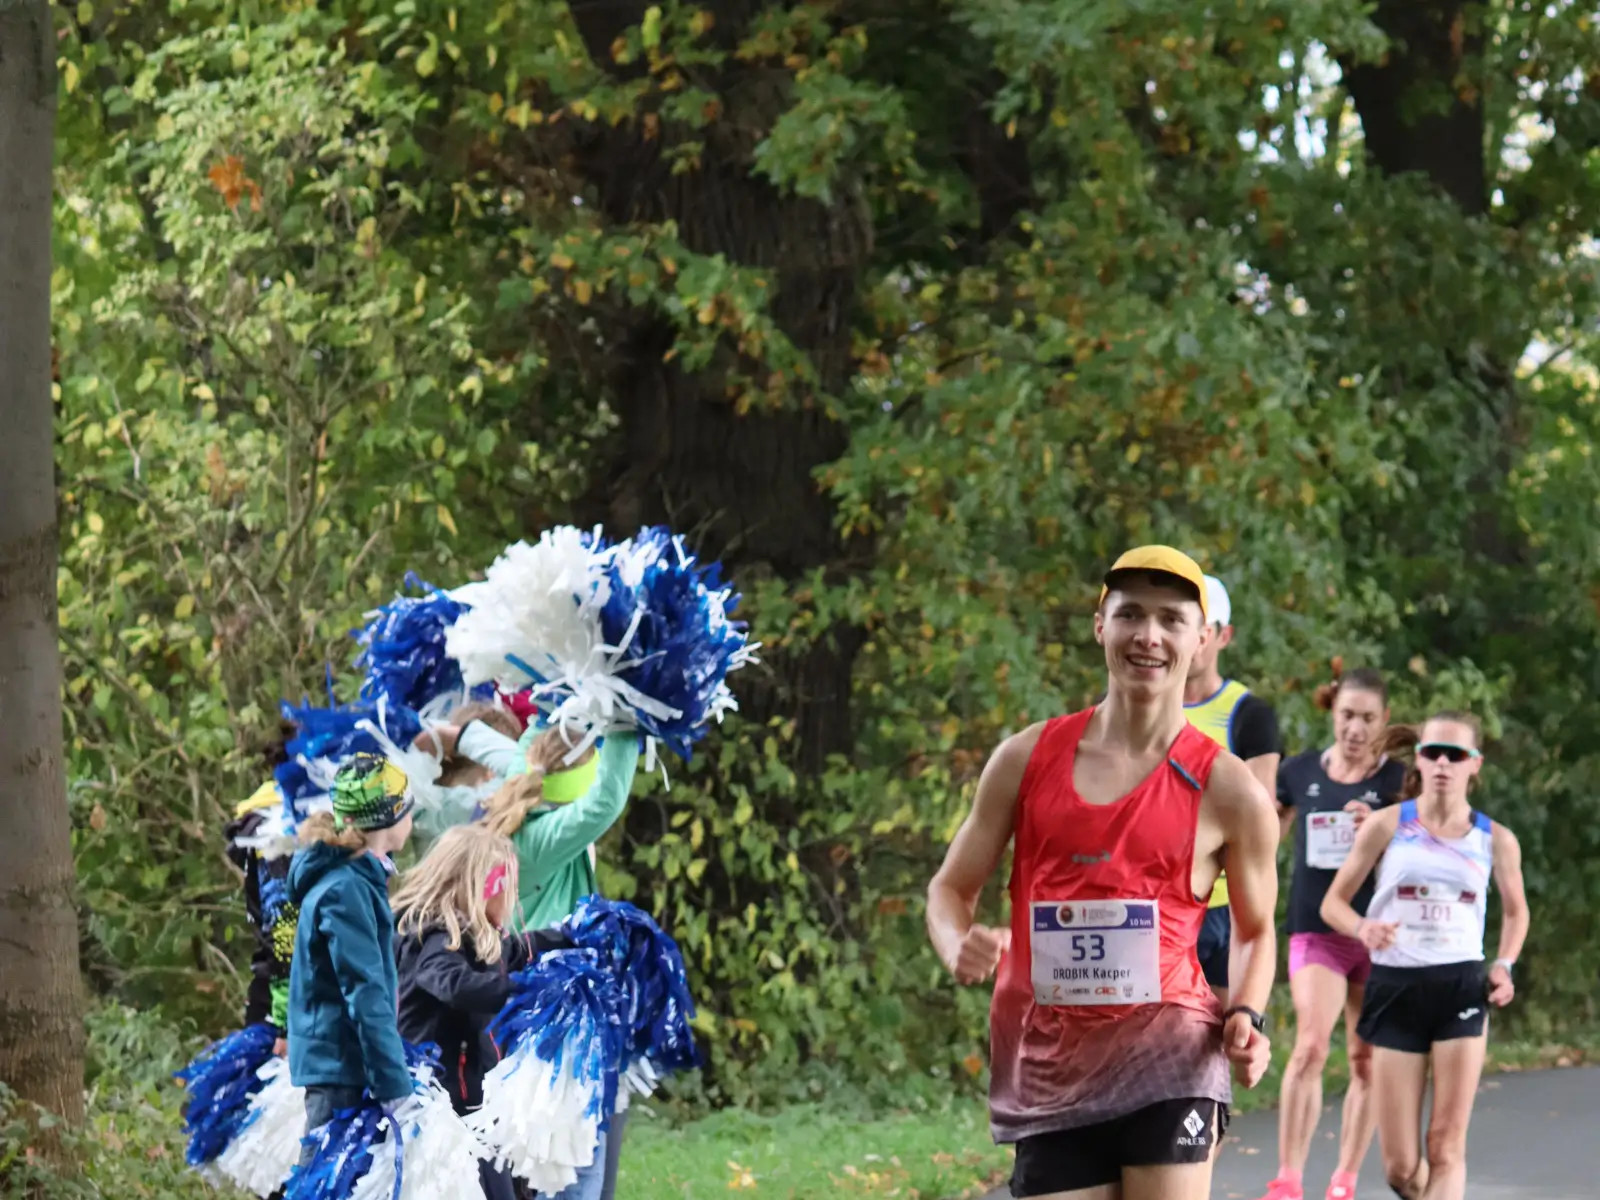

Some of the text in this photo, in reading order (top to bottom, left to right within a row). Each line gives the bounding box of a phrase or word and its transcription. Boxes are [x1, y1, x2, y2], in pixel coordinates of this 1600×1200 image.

[1420, 904, 1451, 921] 101
[1130, 918, 1152, 926] 10 km
[1072, 934, 1105, 961] 53
[1053, 967, 1131, 980] DROBIK Kacper
